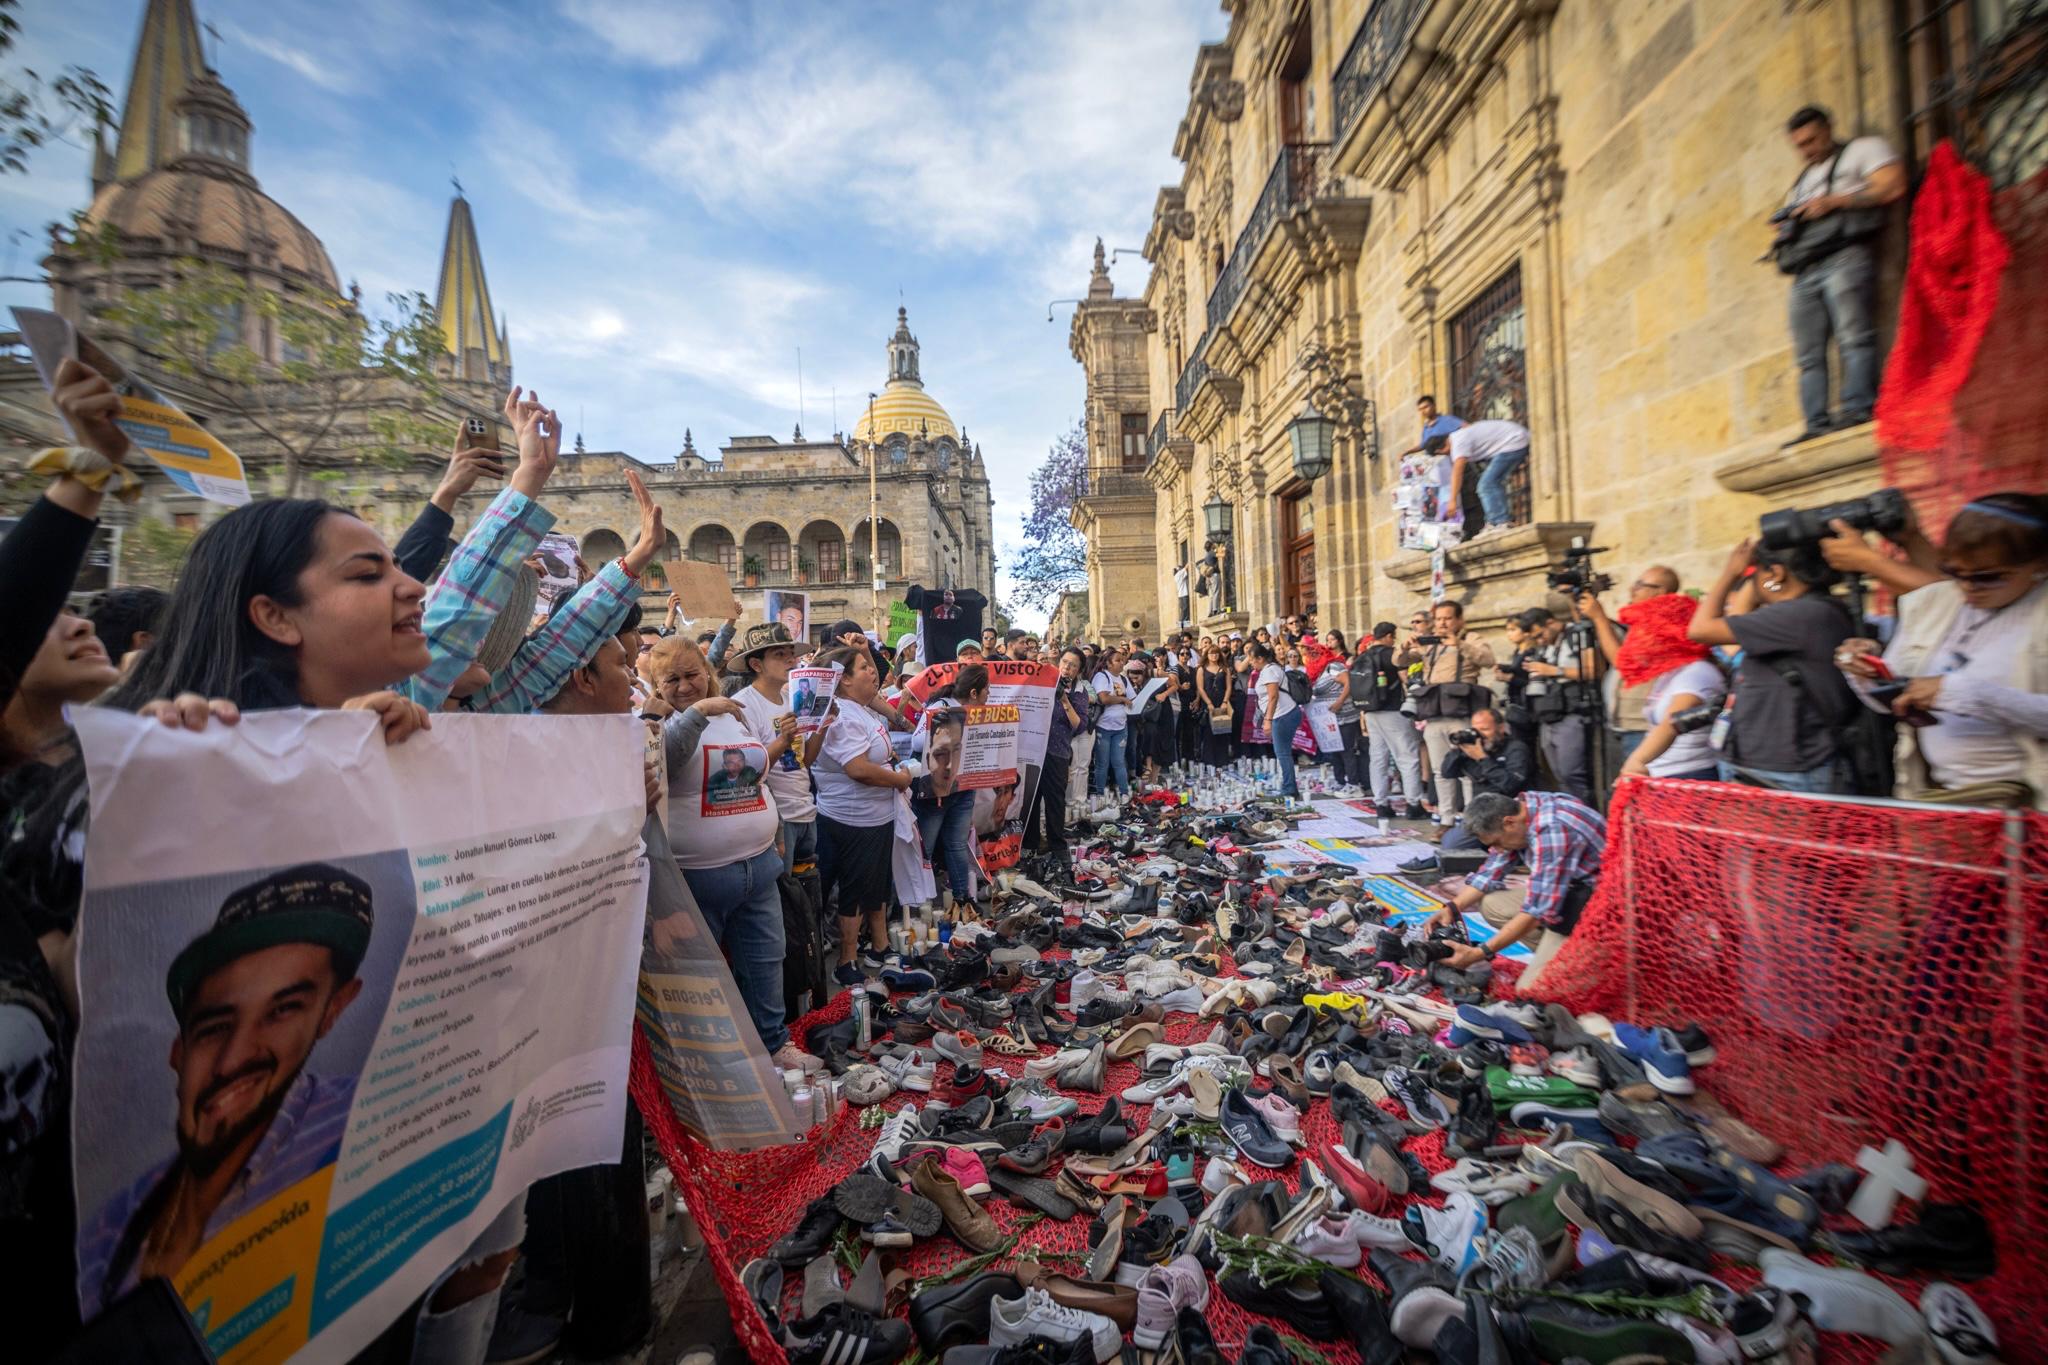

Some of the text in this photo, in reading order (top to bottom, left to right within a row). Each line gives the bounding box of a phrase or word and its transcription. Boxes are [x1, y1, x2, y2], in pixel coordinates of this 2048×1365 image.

[968, 705, 1019, 724] SE BUSCA
[416, 854, 450, 868] Nombre:
[508, 836, 533, 849] Gómez
[444, 875, 453, 887] 31
[487, 884, 510, 897] Lunar
[511, 880, 521, 890] en
[522, 874, 543, 886] cuello
[544, 870, 557, 881] lado
[423, 929, 436, 941] en
[439, 926, 447, 937] la
[474, 908, 504, 925] Tatuajes:
[507, 902, 516, 913] en
[518, 896, 537, 910] torso
[538, 892, 551, 903] lado
[406, 948, 446, 967] leyenda
[491, 929, 500, 941] un
[397, 980, 410, 991] en
[412, 969, 452, 988] espalda
[398, 1118, 410, 1131] de
[412, 1101, 443, 1123] agosto
[445, 1095, 457, 1107] de
